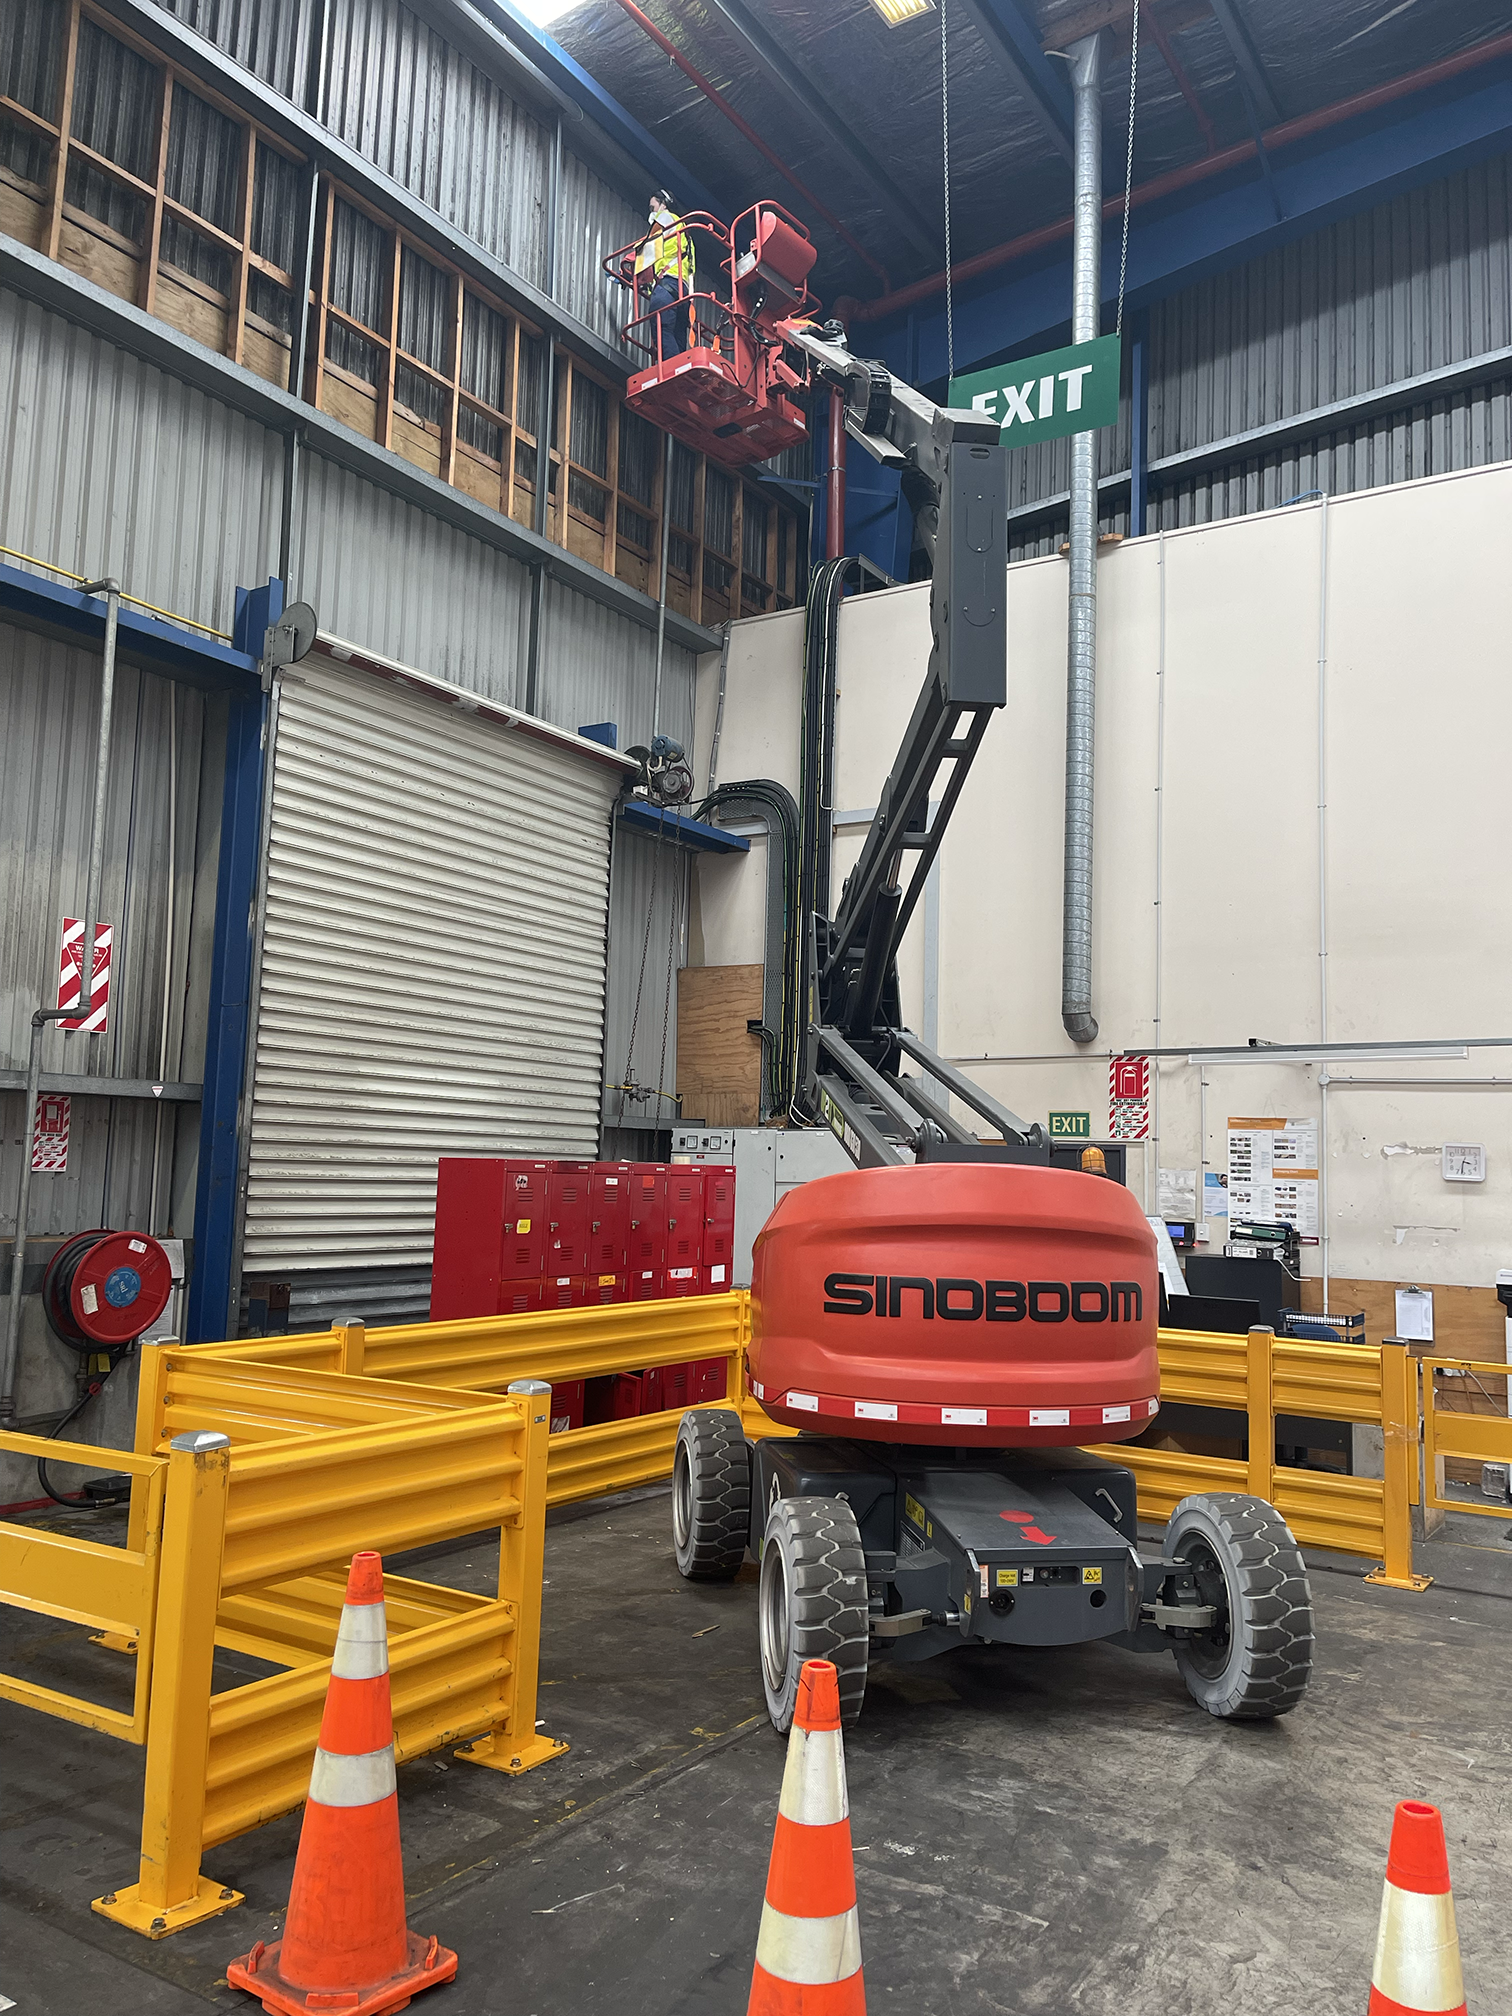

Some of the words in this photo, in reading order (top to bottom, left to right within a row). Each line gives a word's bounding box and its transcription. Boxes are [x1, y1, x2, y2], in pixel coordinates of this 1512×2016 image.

[972, 364, 1093, 429] EXIT
[1052, 1116, 1087, 1133] EXIT
[823, 1272, 1142, 1322] SINOBOOM
